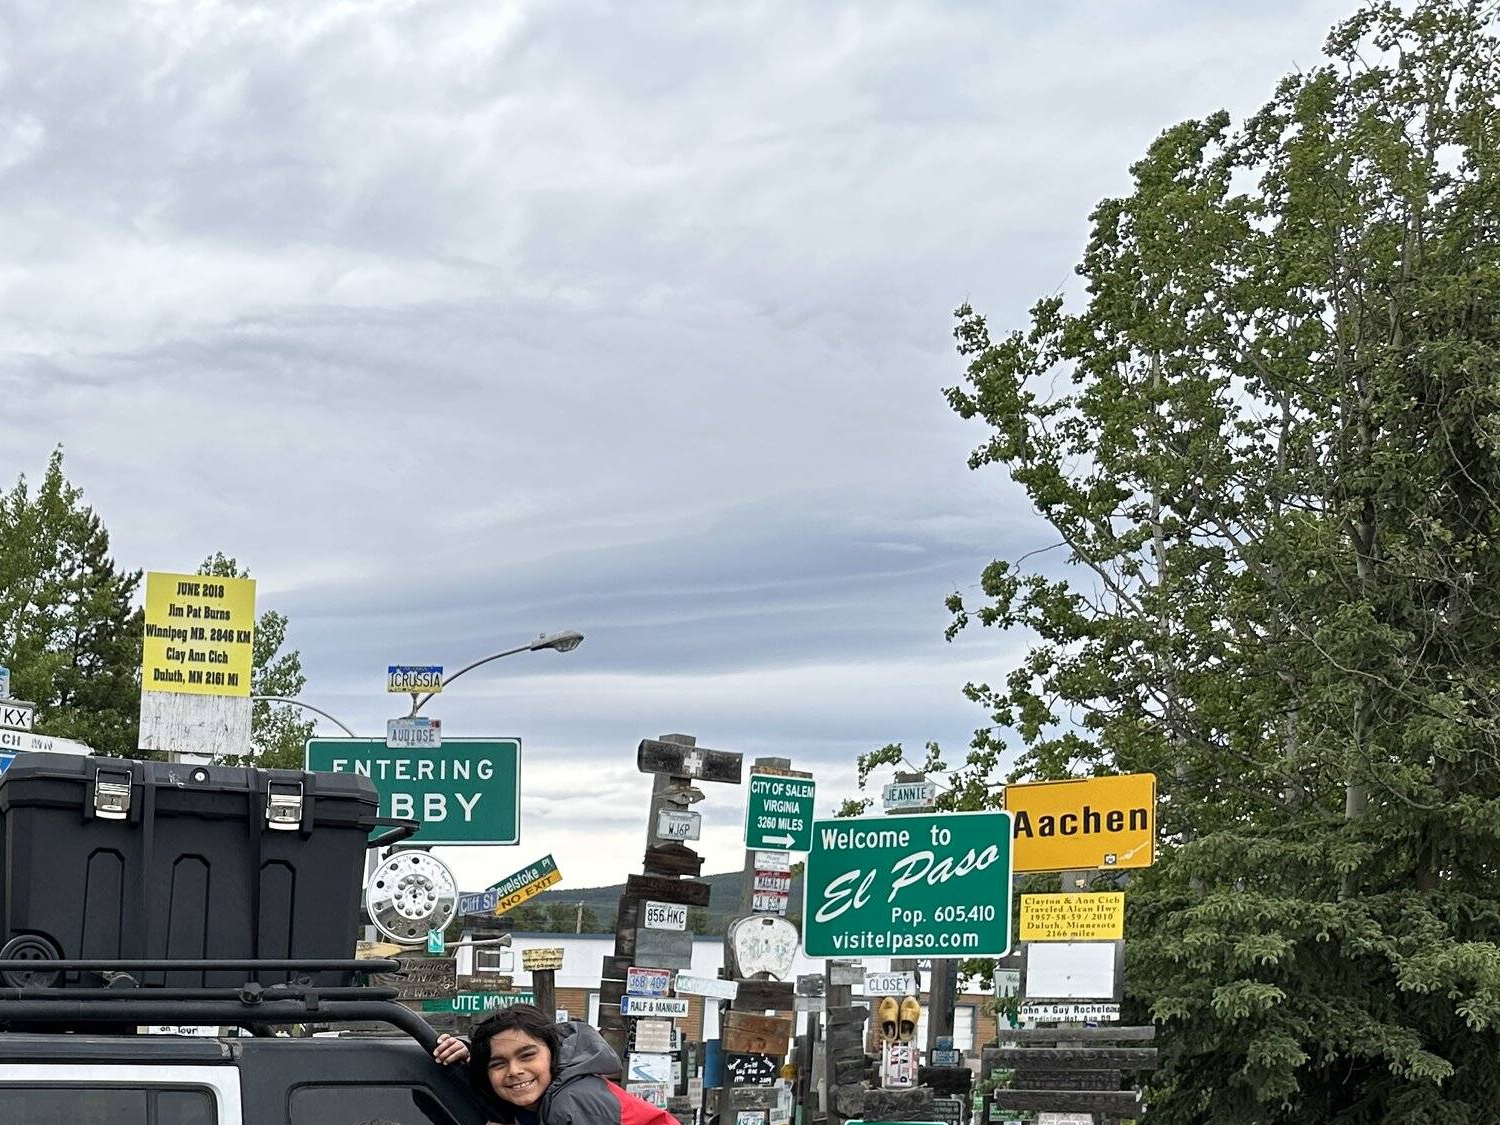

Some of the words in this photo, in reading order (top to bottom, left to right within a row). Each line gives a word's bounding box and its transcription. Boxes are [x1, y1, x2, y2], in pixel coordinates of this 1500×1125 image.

[177, 582, 200, 596] JUNE
[202, 584, 224, 598] 2018
[169, 604, 186, 617] Jim
[188, 605, 202, 619] Pat
[204, 606, 230, 621] Burns
[146, 624, 188, 642] Winnipeg
[210, 629, 232, 642] 2846
[236, 631, 251, 644] KM
[166, 647, 183, 663] Clay
[185, 649, 206, 662] Ann
[188, 670, 203, 684] MN
[205, 671, 225, 685] 2161
[333, 759, 493, 780] ENTERING
[752, 781, 771, 795] CITY
[772, 783, 784, 795] OF
[785, 784, 814, 798] SALEM
[763, 800, 800, 814] VIRGINIA
[758, 816, 776, 829] 3260
[778, 818, 803, 831] MILES
[1014, 807, 1148, 839] Aachen
[821, 828, 909, 851] Welcome
[930, 825, 951, 846] to
[502, 896, 522, 910] NO
[525, 874, 554, 898] EXIT
[815, 868, 877, 923] El
[888, 844, 1000, 903] Paso
[892, 907, 926, 927] Pop.
[934, 905, 995, 923] 605,410
[832, 931, 979, 953] visitelpaso.com
